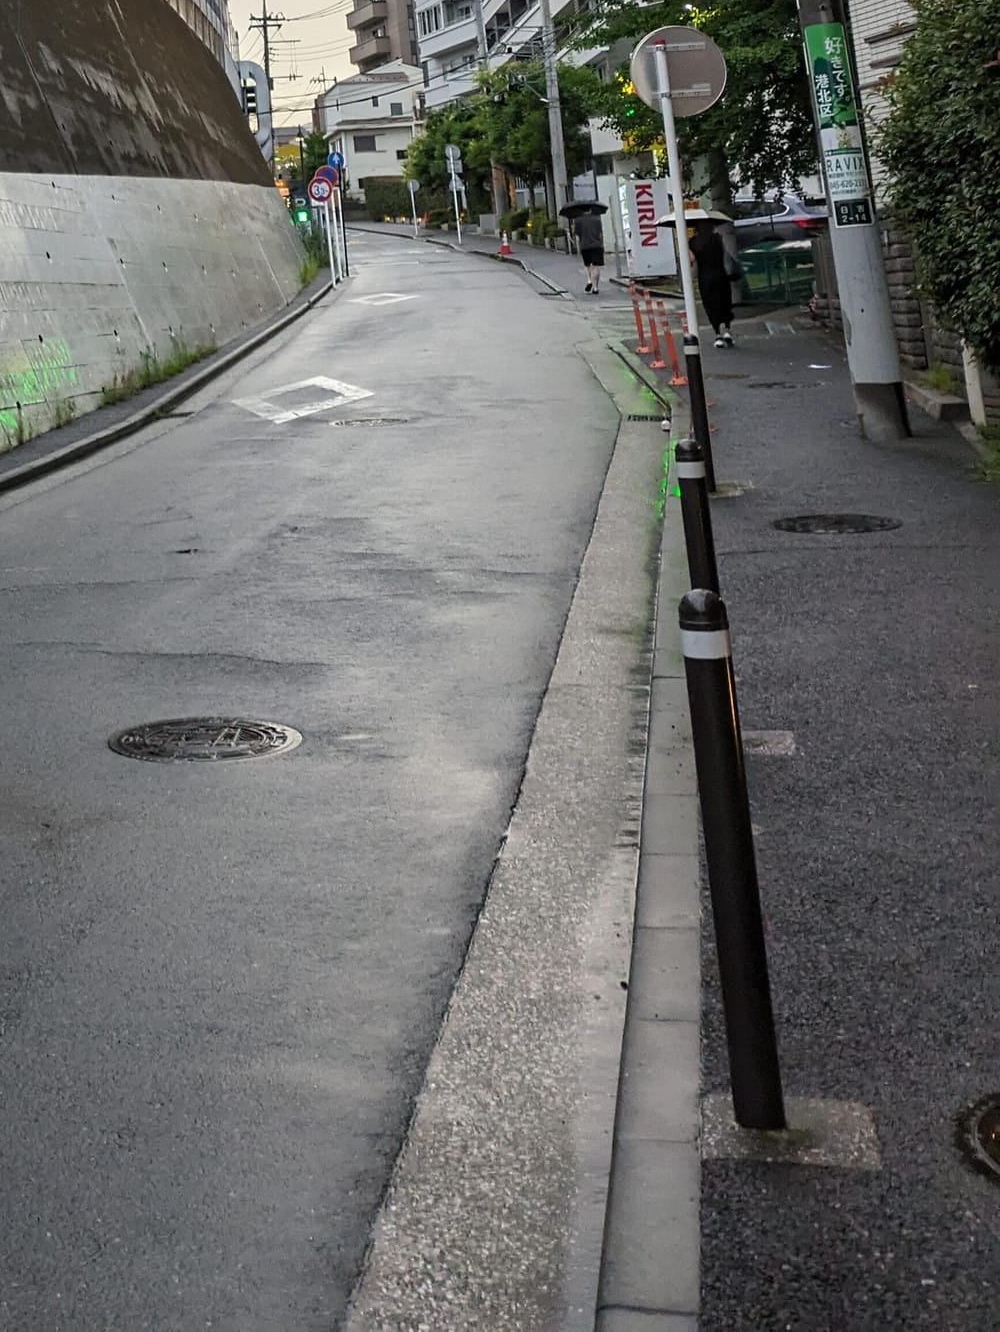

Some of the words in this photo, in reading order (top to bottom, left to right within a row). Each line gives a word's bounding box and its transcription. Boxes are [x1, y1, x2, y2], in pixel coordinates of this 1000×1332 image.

[824, 37, 850, 101] 好きです。
[815, 74, 835, 118] 港北区
[826, 156, 865, 172] RAVIX
[635, 184, 658, 247] KIRIN
[841, 214, 867, 223] 2-14
